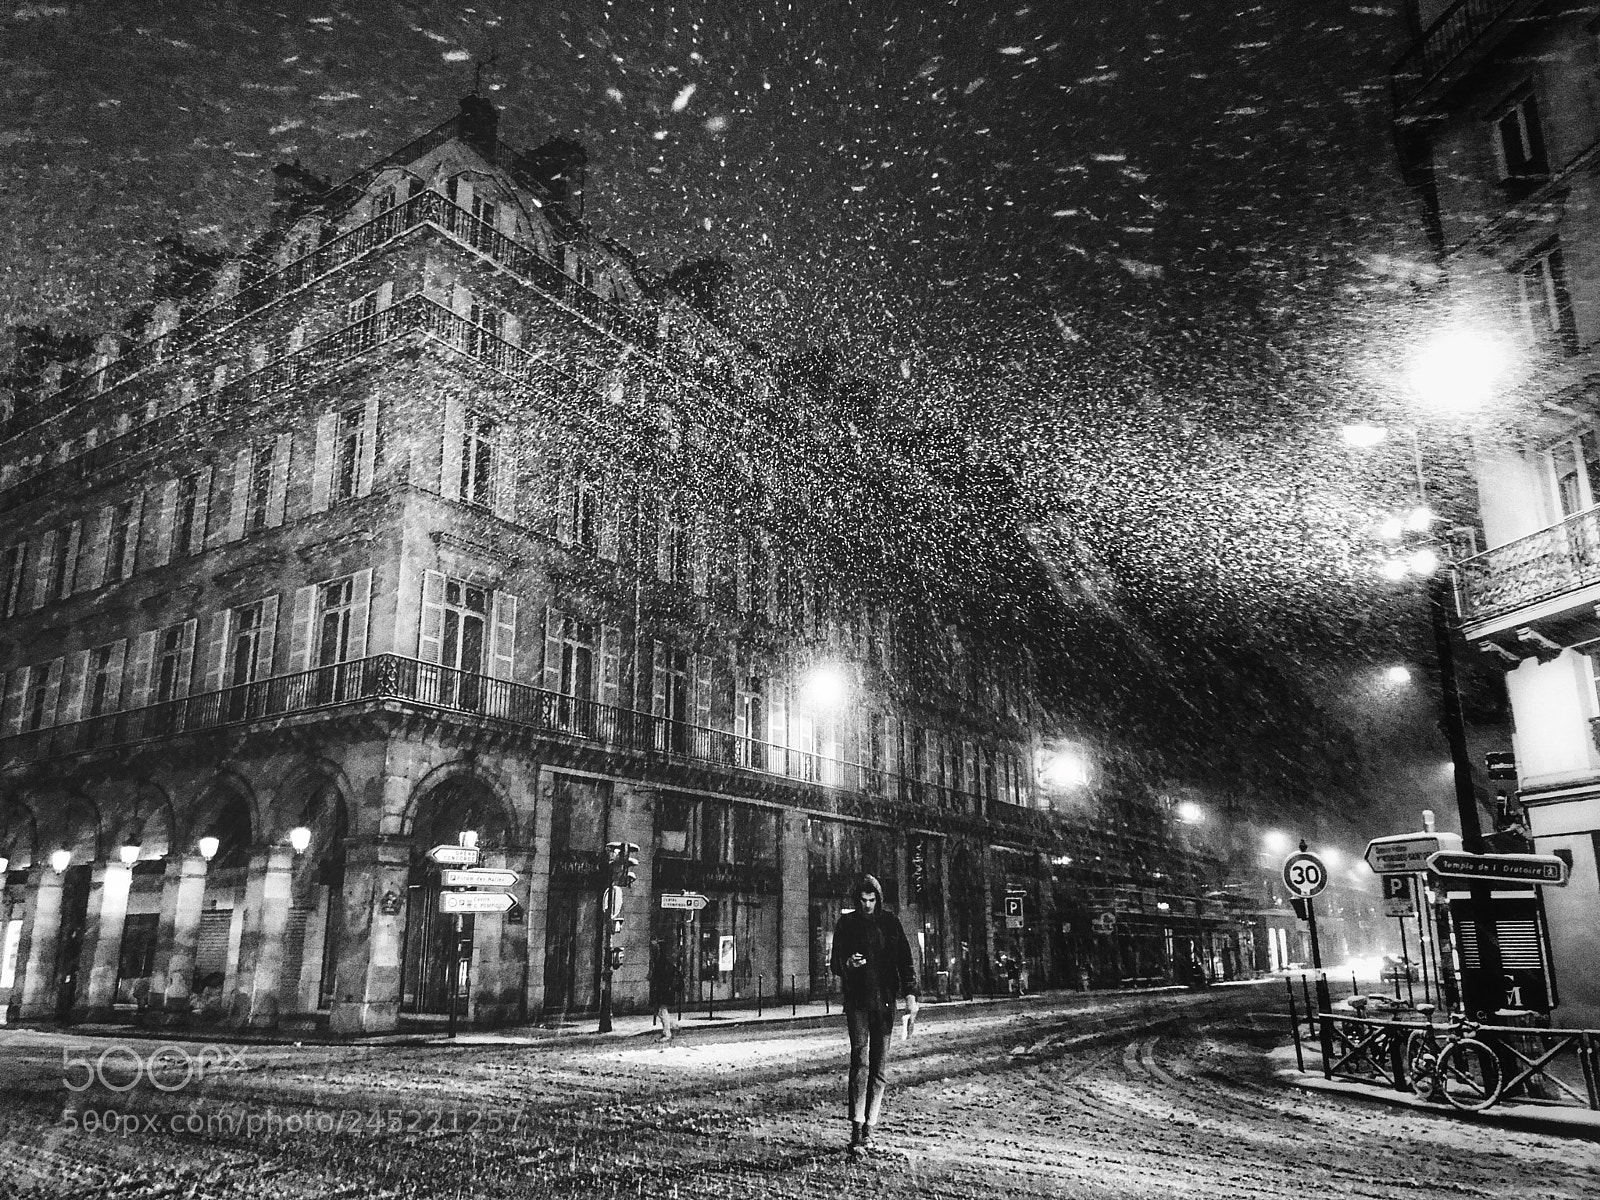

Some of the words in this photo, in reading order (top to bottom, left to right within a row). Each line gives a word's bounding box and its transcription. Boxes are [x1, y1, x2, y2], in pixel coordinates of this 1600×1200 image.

[1443, 860, 1474, 870] Temple
[1478, 863, 1489, 871] de
[1292, 864, 1319, 885] 30
[1390, 878, 1402, 894] P
[1010, 901, 1018, 914] P
